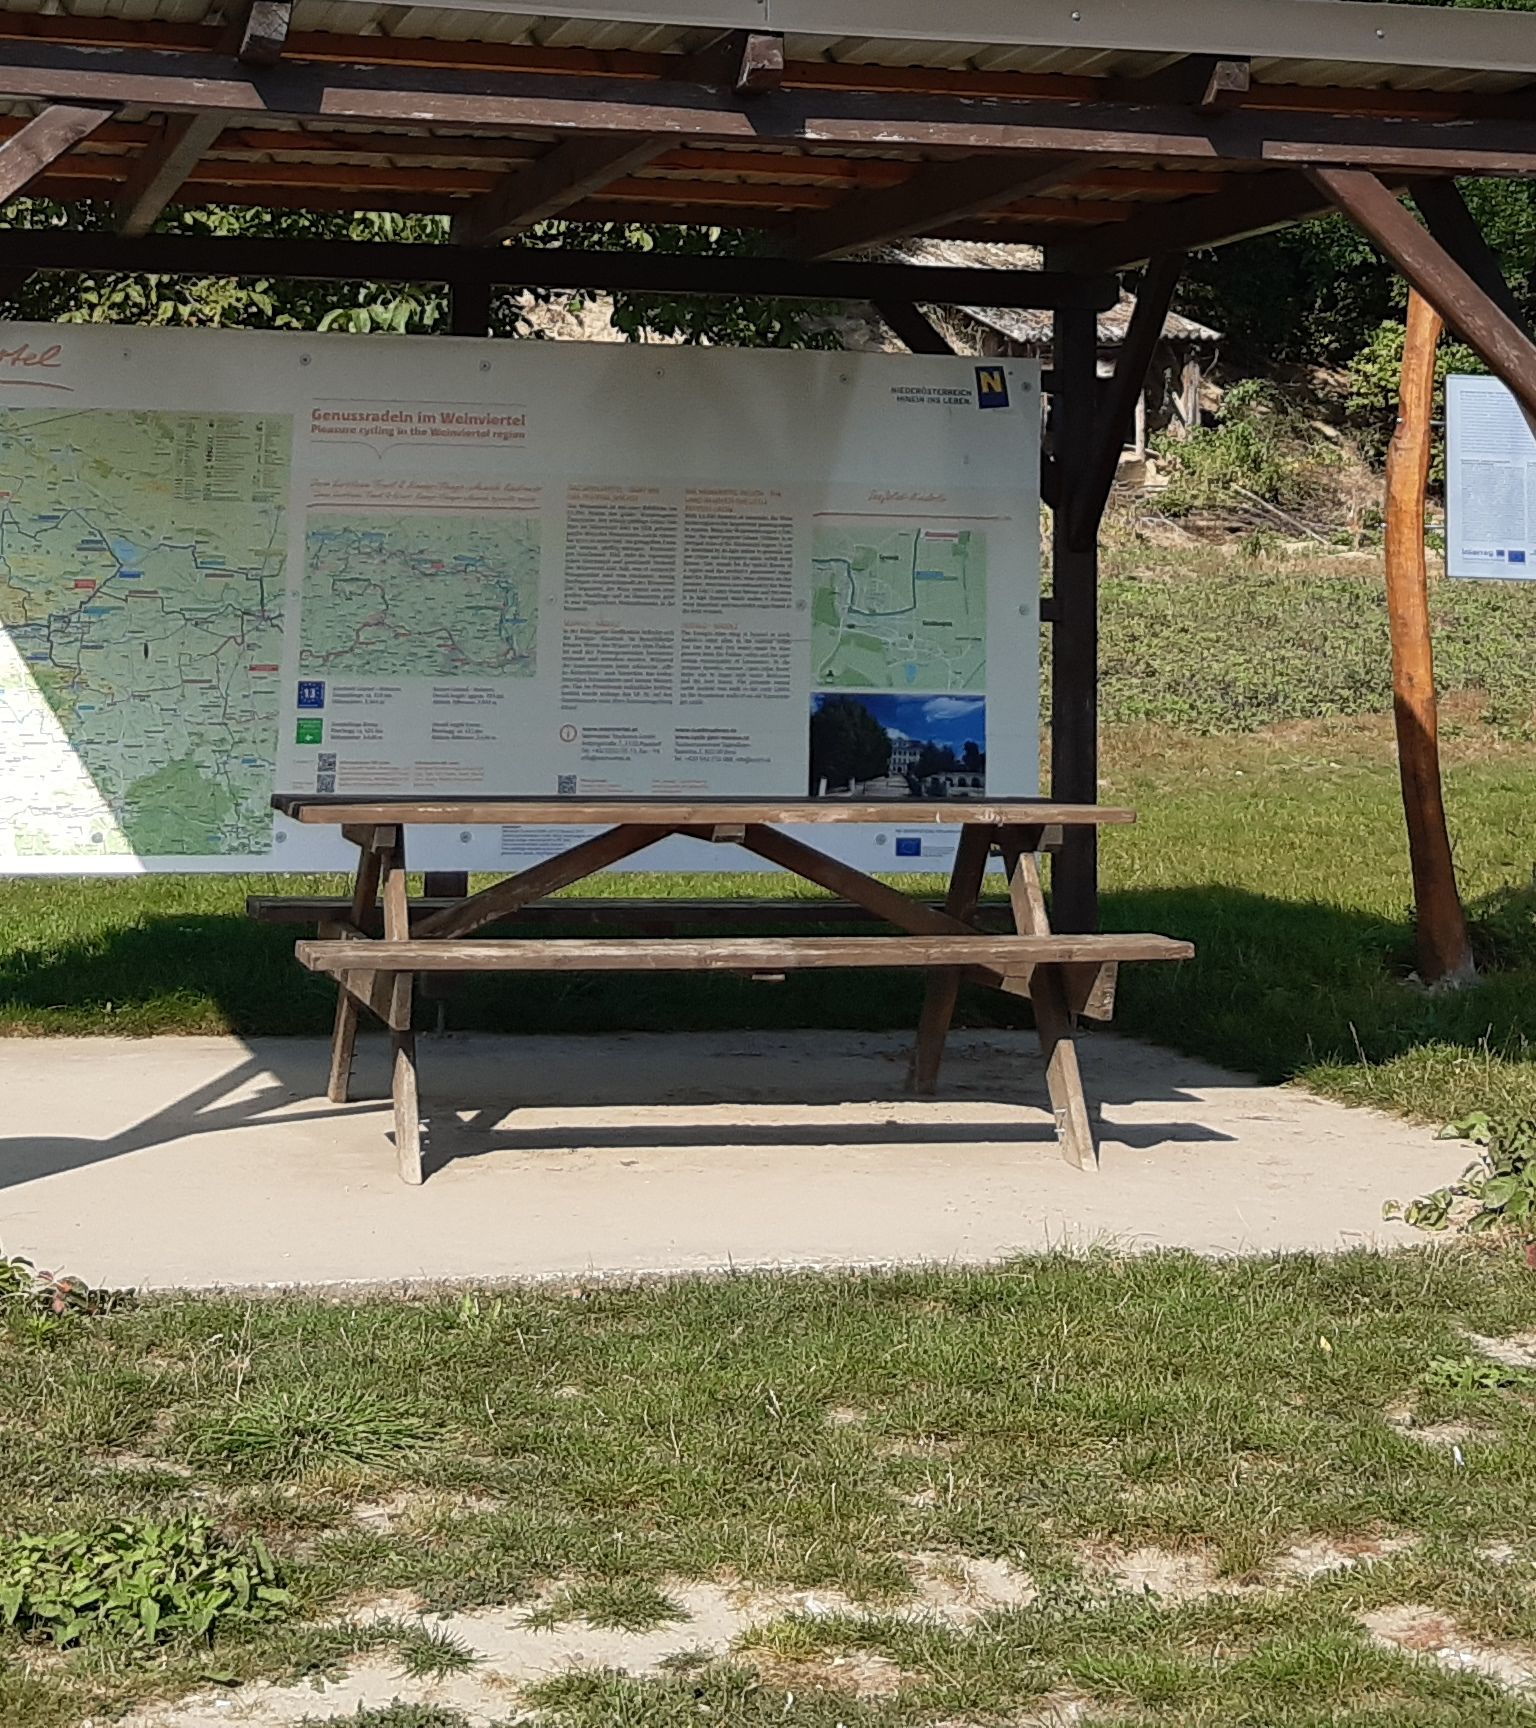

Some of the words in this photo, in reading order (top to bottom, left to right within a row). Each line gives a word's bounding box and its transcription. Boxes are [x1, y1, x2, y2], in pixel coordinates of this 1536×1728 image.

[979, 371, 1003, 393] N
[311, 408, 413, 422] Genussradeln
[417, 411, 436, 423] im
[440, 412, 526, 427] Weinviertel
[409, 426, 427, 436] the
[430, 427, 491, 439] Weinviertel
[493, 431, 526, 441] region
[303, 687, 316, 699] 13
